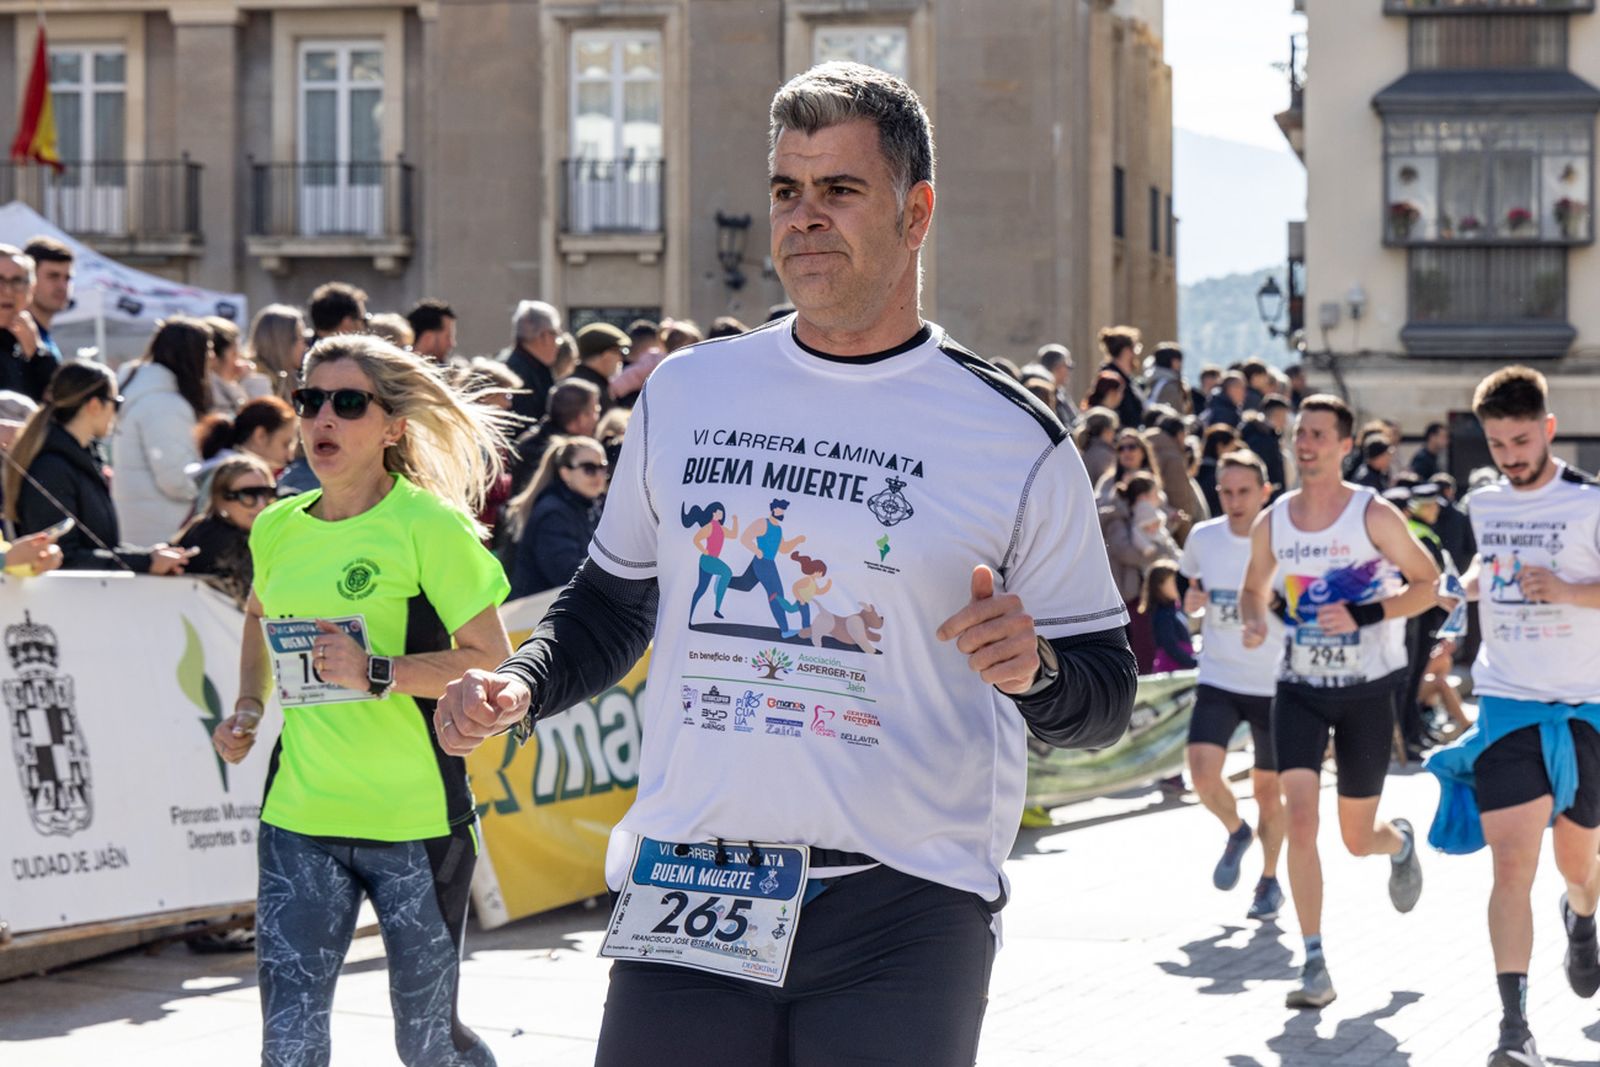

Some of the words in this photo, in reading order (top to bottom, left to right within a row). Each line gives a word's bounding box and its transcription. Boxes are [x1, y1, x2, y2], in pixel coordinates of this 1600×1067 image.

[694, 429, 709, 446] VI
[713, 430, 806, 455] CARRERA
[814, 441, 924, 478] CAMINATA
[682, 457, 753, 486] BUENA
[761, 462, 868, 503] MUERTE
[689, 651, 698, 660] En
[700, 651, 730, 662] beneficio
[732, 655, 743, 663] de
[798, 653, 842, 666] Asociación
[1309, 646, 1346, 666] 294
[797, 663, 867, 682] ASPERGER-TEA
[846, 681, 866, 693] Jaén
[702, 708, 728, 719] BYD
[843, 714, 881, 727] VICTORIA
[12, 853, 71, 880] CIUDAD
[73, 850, 89, 873] DE
[93, 842, 130, 871] JAÉN
[659, 843, 670, 855] VI
[673, 845, 720, 863] CRRER
[650, 863, 695, 885] BUENA
[699, 870, 755, 890] MUERTE
[651, 891, 753, 943] 265
[631, 933, 671, 946] FRANCISCO
[672, 936, 690, 947] JOSE
[691, 938, 721, 950] ESTEBAN
[722, 943, 758, 957] GARRIDO
